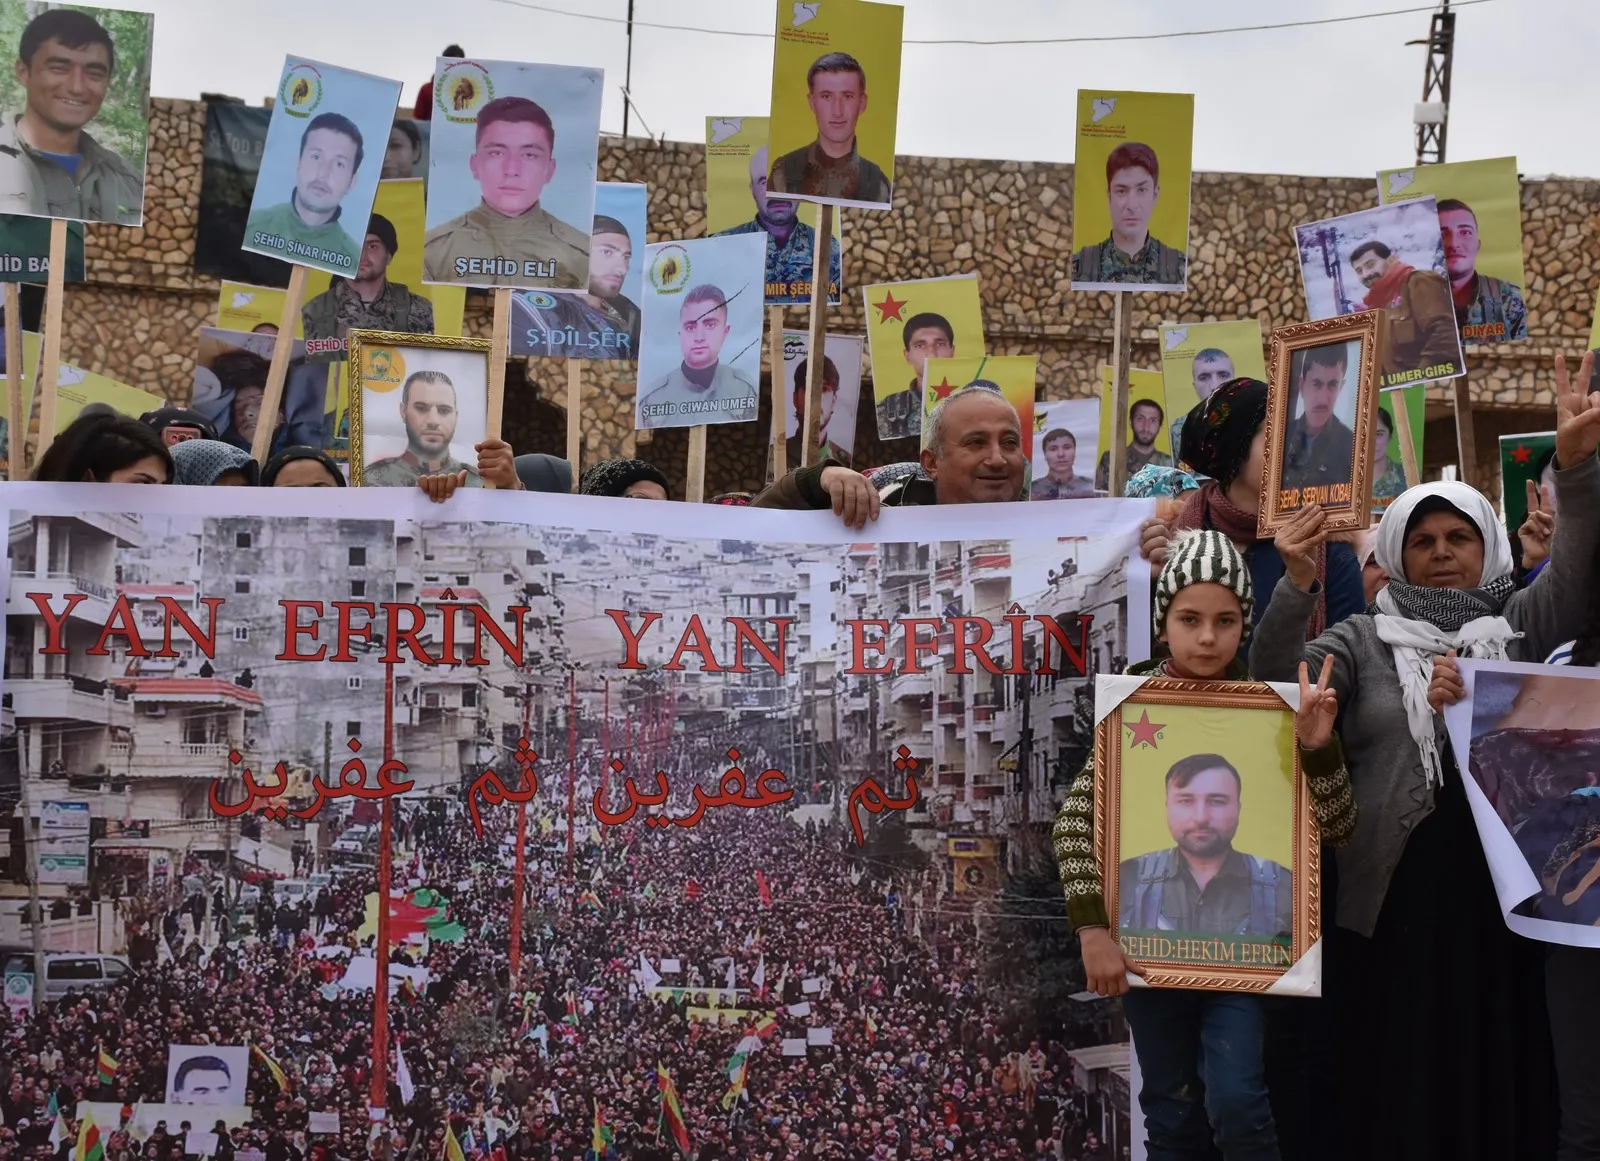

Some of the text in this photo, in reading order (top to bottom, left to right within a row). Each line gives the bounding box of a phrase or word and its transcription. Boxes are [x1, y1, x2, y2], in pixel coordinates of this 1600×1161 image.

[321, 249, 352, 268] HORO
[454, 255, 557, 278] ŞEHÎD ELÎ
[1387, 368, 1422, 385] UMER
[1425, 362, 1454, 378] GIRS
[679, 399, 719, 414] CIWAN
[721, 396, 756, 411] UMER
[25, 587, 1095, 677] YAN EFRÎN YAN EFRÎN
[208, 735, 920, 848] ثم عفرين ثم عفرين
